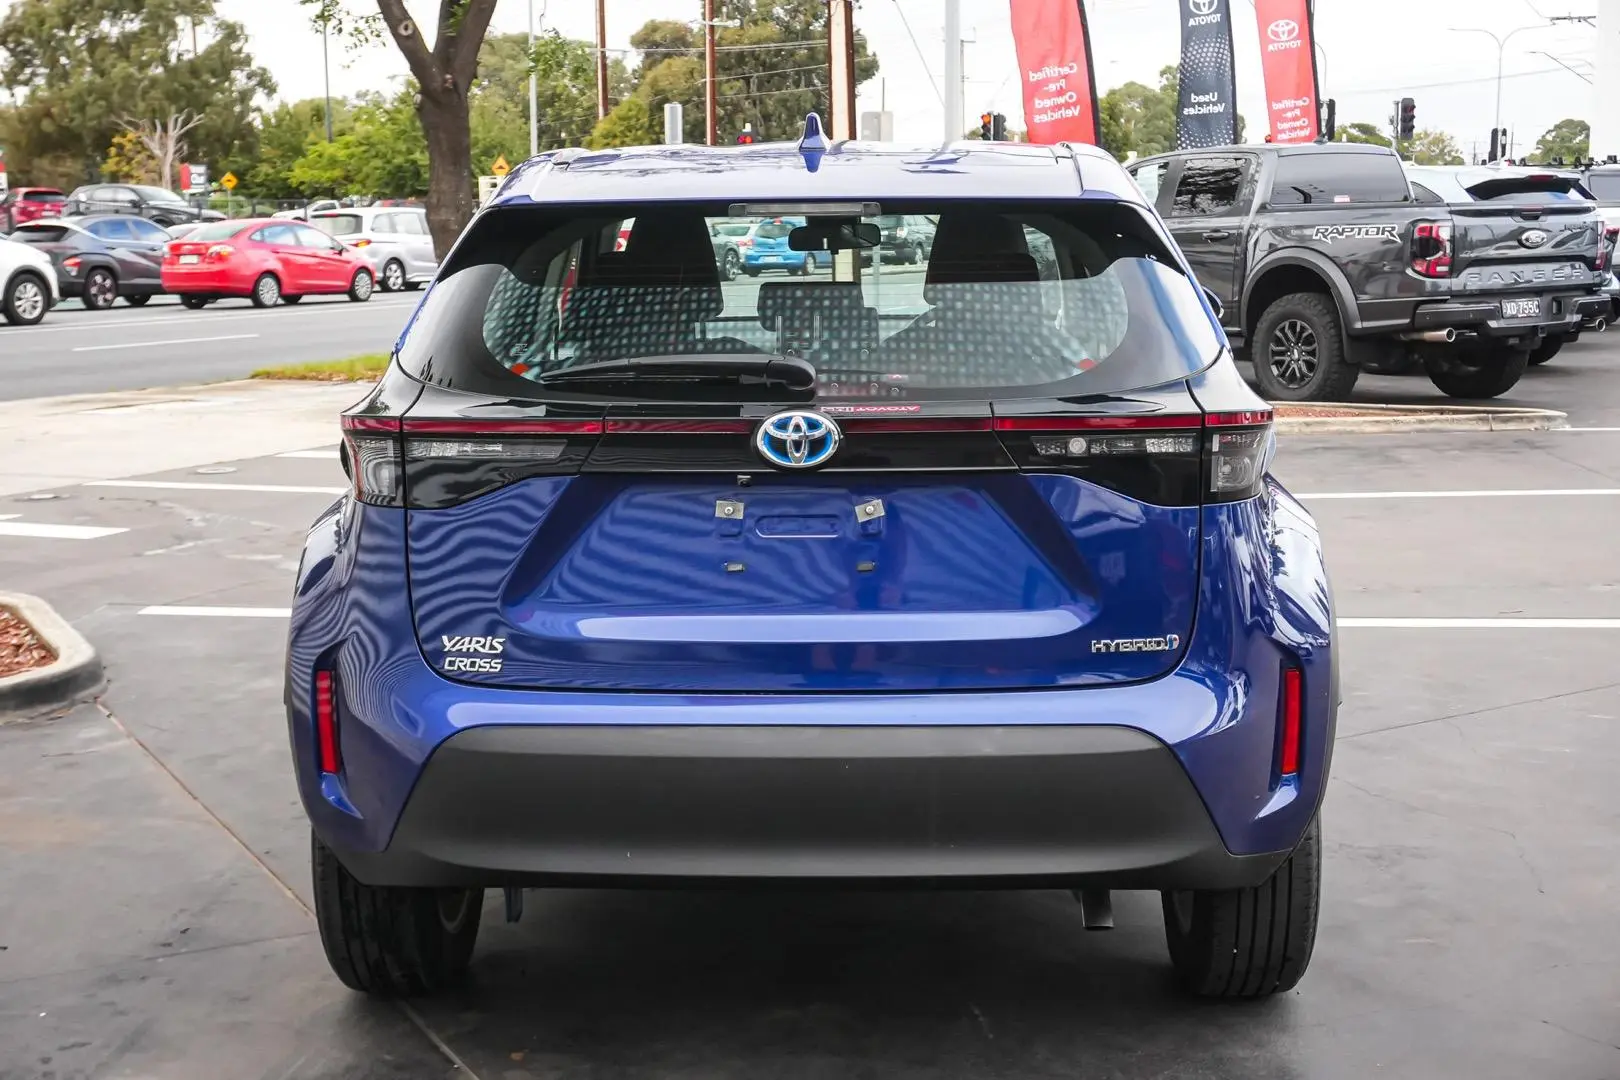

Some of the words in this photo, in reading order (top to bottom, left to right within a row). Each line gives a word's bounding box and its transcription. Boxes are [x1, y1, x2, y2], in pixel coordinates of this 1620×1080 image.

[1312, 224, 1401, 244] RAPTOR
[1466, 265, 1584, 285] RANGER
[441, 635, 506, 654] YARIS
[1091, 638, 1165, 653] HYBRID
[444, 657, 503, 672] CROSS
